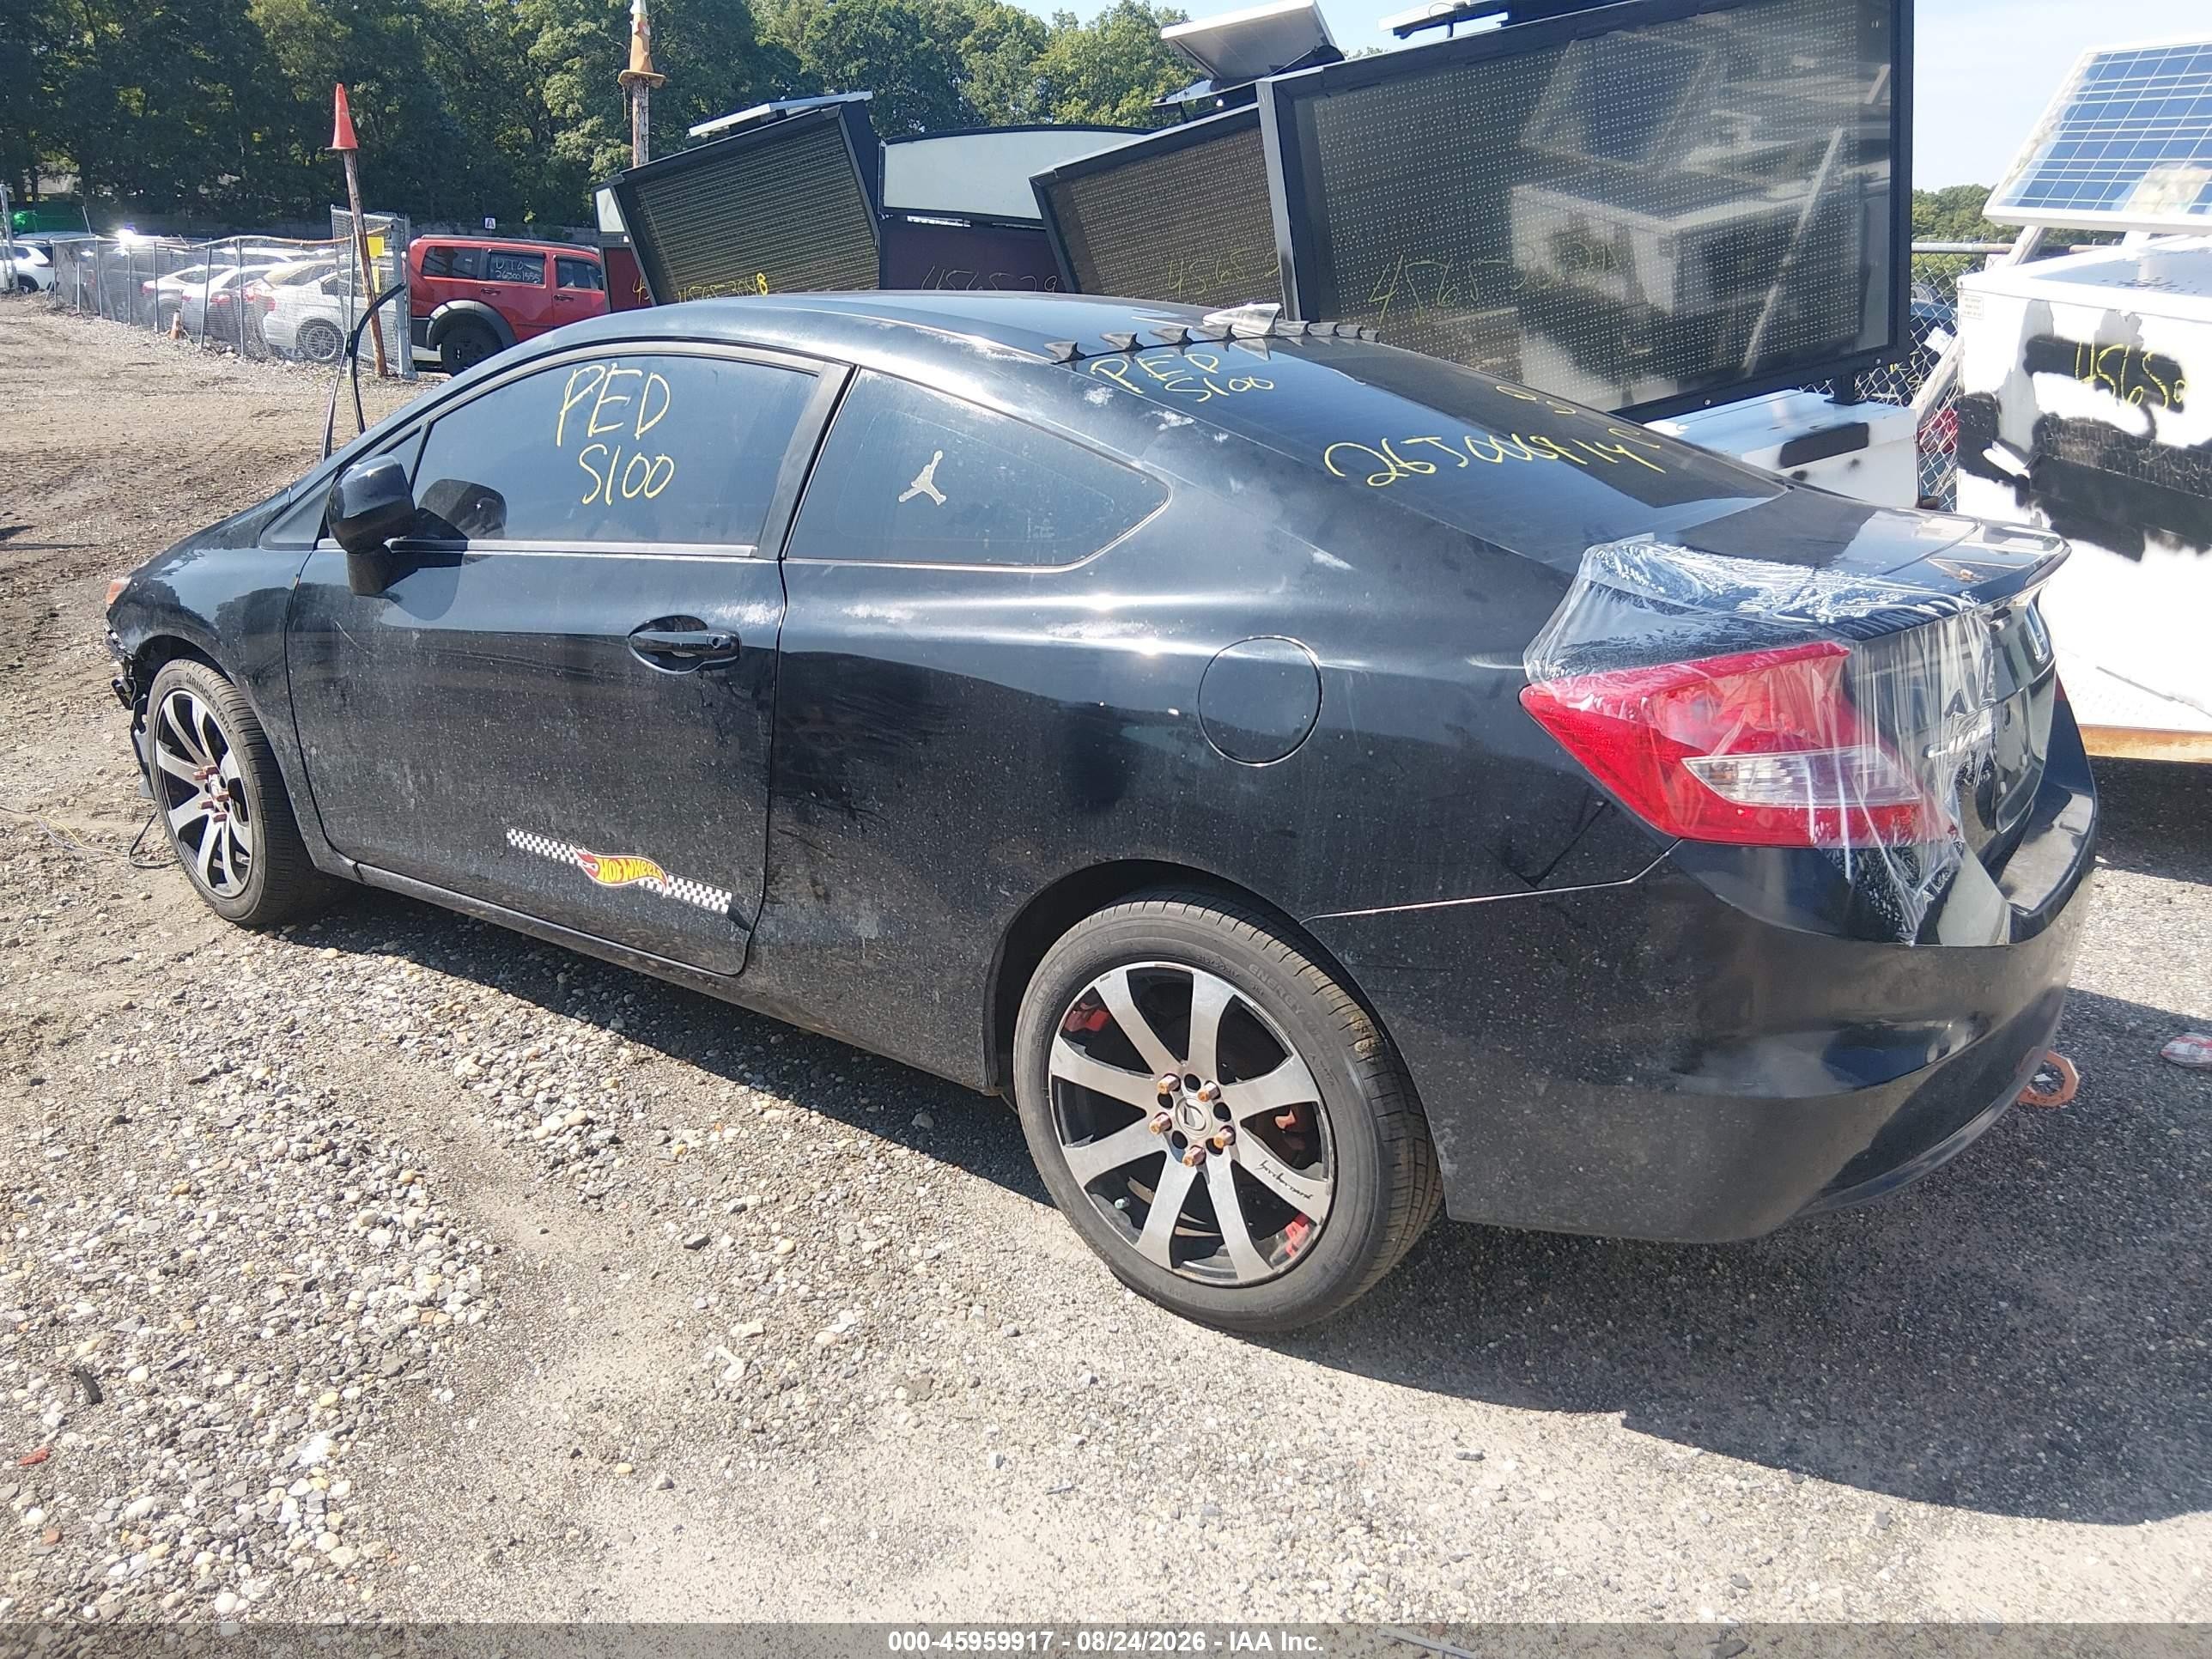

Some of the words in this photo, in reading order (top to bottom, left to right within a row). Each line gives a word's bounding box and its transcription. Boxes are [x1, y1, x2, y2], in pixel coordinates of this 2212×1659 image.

[486, 218, 495, 228] A
[556, 362, 671, 447] PED
[600, 858, 624, 884] HOT
[1249, 963, 1306, 1015] ENERGY
